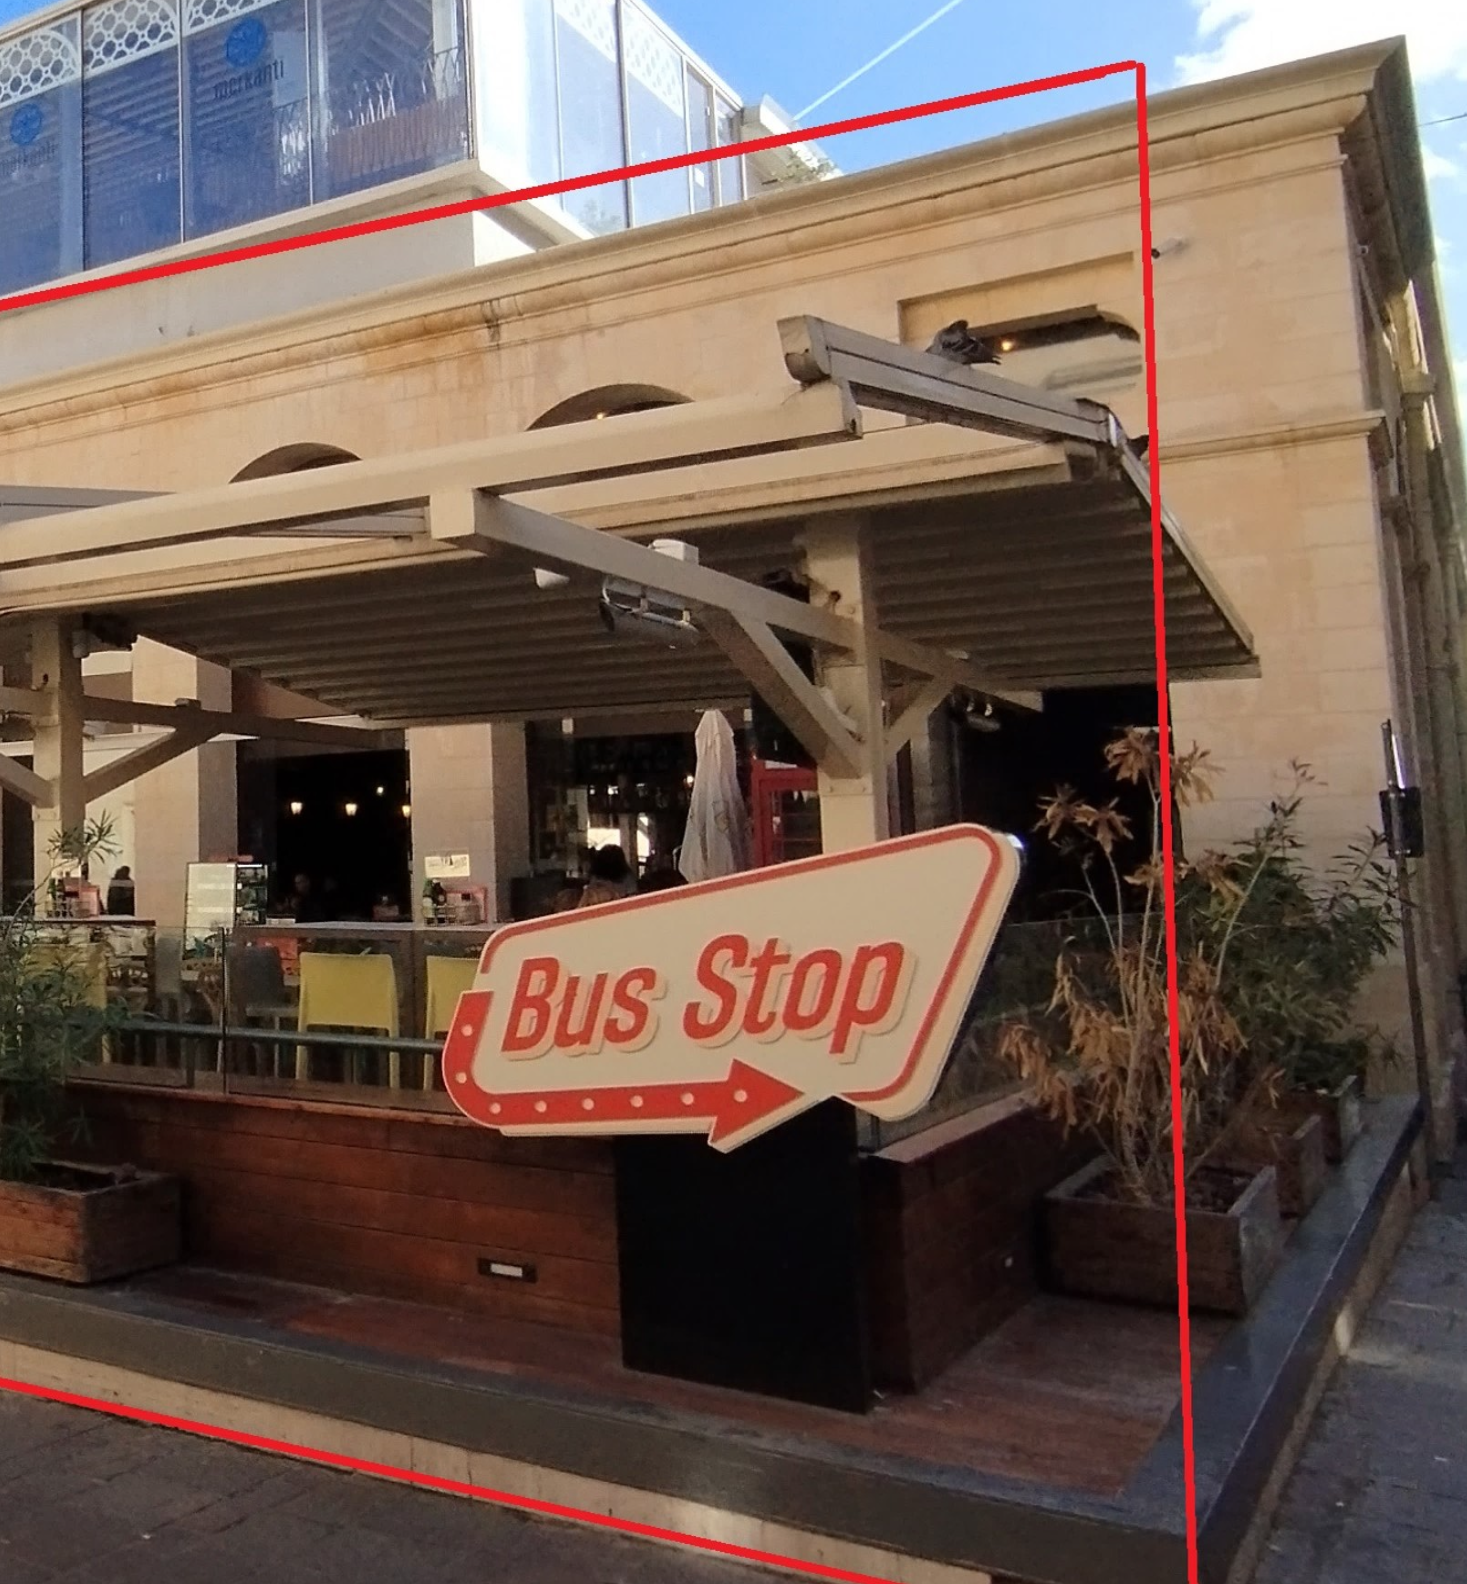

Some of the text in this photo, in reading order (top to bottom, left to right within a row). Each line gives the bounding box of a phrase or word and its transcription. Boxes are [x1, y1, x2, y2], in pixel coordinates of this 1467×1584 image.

[212, 58, 284, 100] merkanti
[501, 933, 906, 1055] Bus Stop
